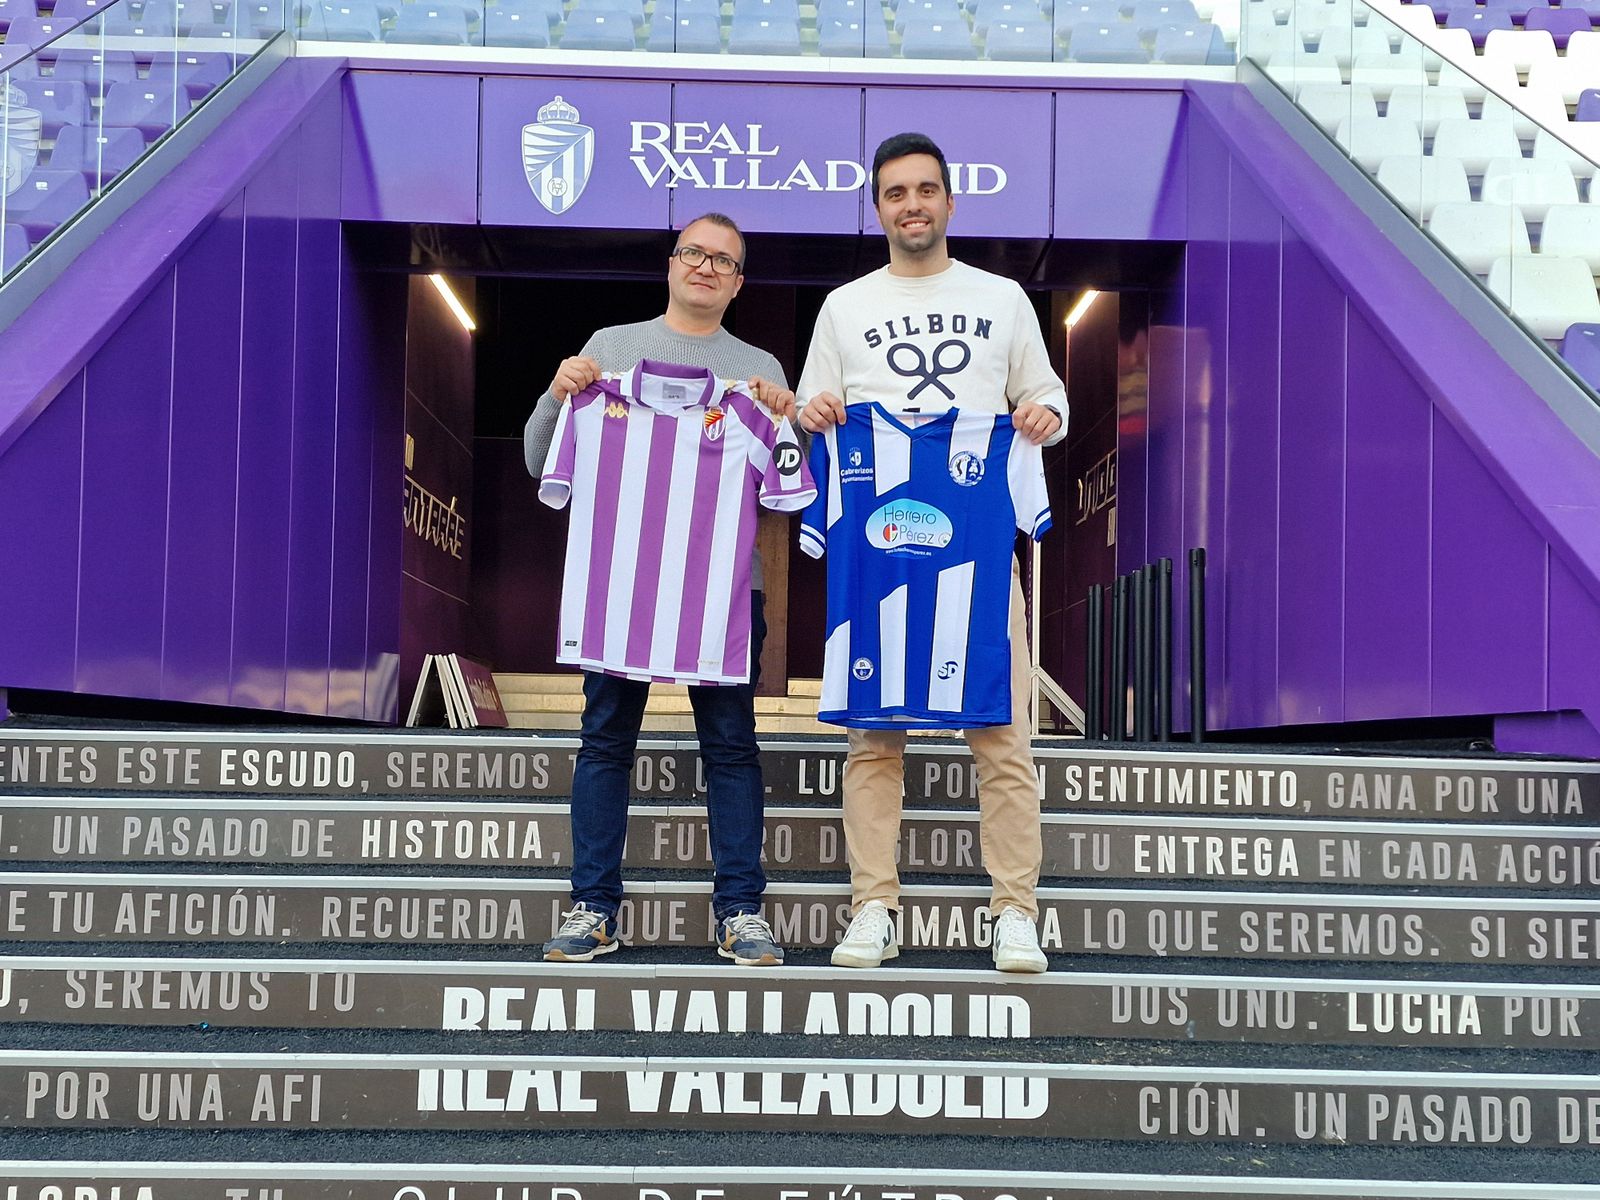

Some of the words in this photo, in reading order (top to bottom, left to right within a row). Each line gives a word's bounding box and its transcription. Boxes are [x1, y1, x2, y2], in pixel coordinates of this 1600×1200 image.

[630, 121, 779, 156] REAL
[630, 156, 1008, 195] VALLADID
[864, 313, 993, 349] SILBON
[777, 448, 800, 469] JD
[884, 506, 937, 525] Herrero
[899, 524, 935, 545] Pérez
[117, 747, 202, 786] ESTE
[219, 749, 370, 794] ESCUDO,
[387, 751, 550, 790] SEREMOS
[1065, 765, 1313, 813] SENTIMIENTO,
[1327, 772, 1417, 811] GANA
[1435, 775, 1499, 813] POR
[1517, 778, 1584, 815] UNA
[52, 815, 99, 855] UN
[122, 816, 268, 857] PASADO
[291, 819, 335, 858] DE
[361, 819, 561, 866] HISTORIA,
[653, 822, 793, 863] FUTO
[1069, 832, 1111, 872] TU
[1134, 834, 1300, 877] ENTREGA
[1319, 838, 1361, 878] EN
[1382, 840, 1479, 881] CADA
[48, 891, 95, 934] TU
[114, 888, 291, 938] AFICIÓN.
[321, 896, 526, 940] RECUERDA
[617, 899, 687, 945] QUE
[897, 904, 1063, 949] IMAGA
[1084, 909, 1126, 950] LO
[1147, 909, 1219, 957] QUE
[1239, 911, 1440, 957] SEREMOS.
[1470, 916, 1506, 957] SI
[1528, 917, 1600, 960] SIE
[65, 970, 271, 1012] SEREMOS
[1348, 993, 1482, 1035] LUCHA
[1504, 997, 1582, 1037] POR
[26, 1072, 110, 1120] POR
[137, 1073, 225, 1121] UNA
[250, 1073, 322, 1122] AFI
[1294, 1092, 1348, 1141] UN
[1368, 1093, 1533, 1144] PASADO
[1558, 1097, 1600, 1146] DE
